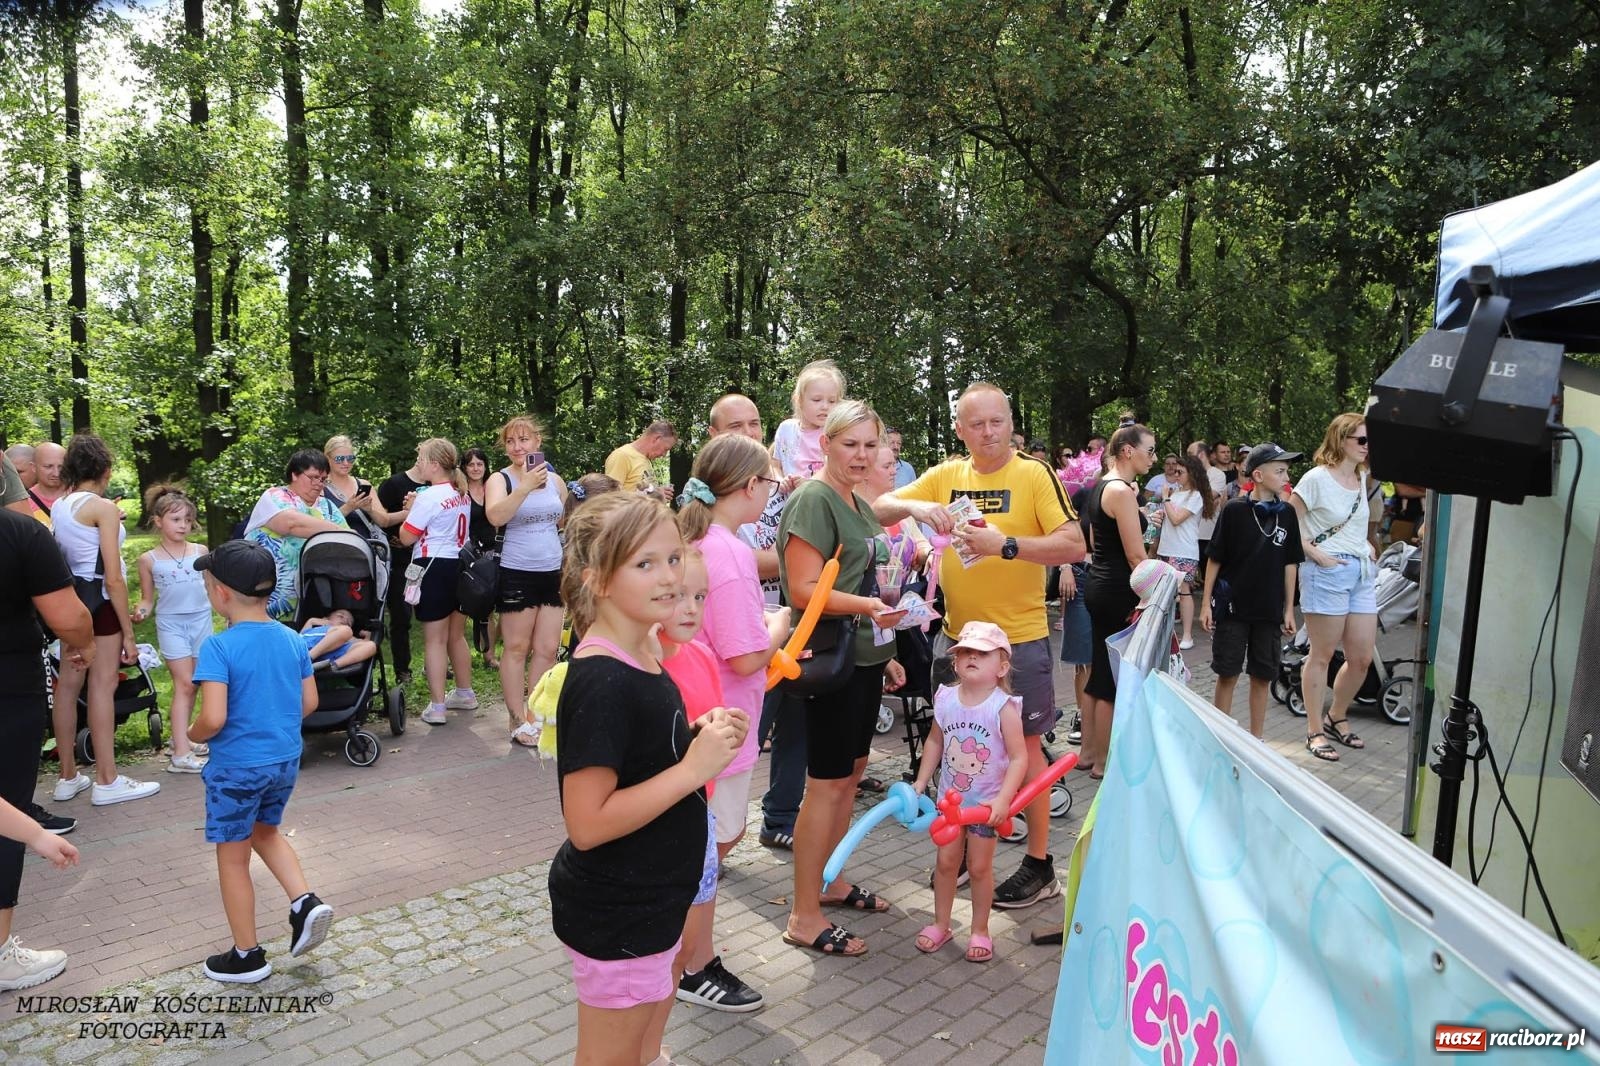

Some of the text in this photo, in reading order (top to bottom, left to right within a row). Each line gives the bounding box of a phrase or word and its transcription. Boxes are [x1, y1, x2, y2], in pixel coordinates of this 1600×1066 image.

[1429, 353, 1518, 378] BULE
[943, 721, 992, 738] HELLO KITTY
